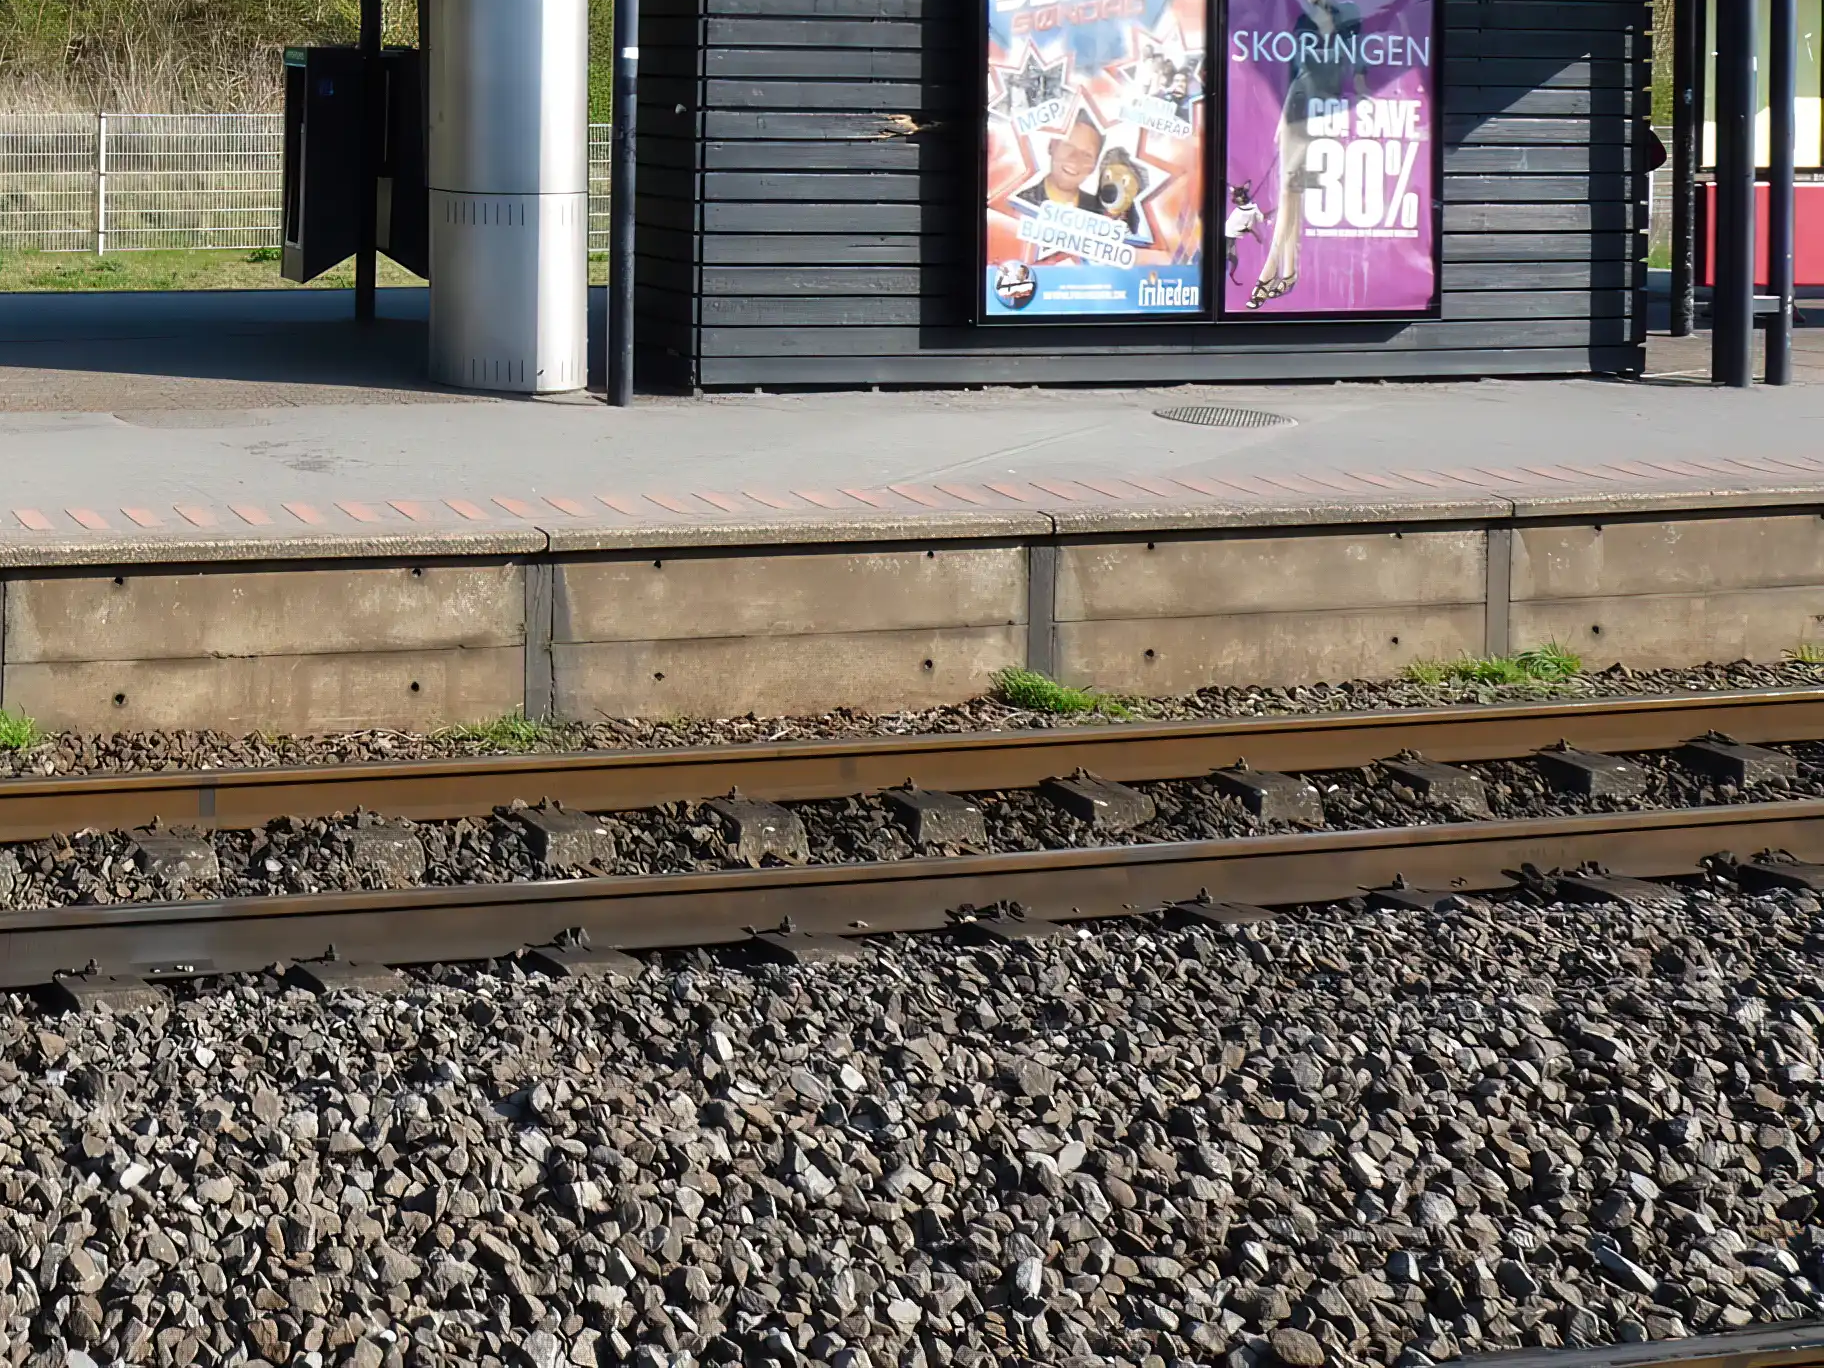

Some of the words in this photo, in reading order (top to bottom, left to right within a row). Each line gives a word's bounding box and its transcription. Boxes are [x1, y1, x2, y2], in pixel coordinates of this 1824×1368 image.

[1231, 30, 1431, 67] SKORINGEN
[1017, 101, 1060, 133] MGP
[1307, 97, 1350, 138] GO!
[1355, 98, 1422, 139] SAVE
[1303, 137, 1420, 229] 30%
[1042, 203, 1124, 242] SIGURDS
[1137, 279, 1200, 307] friheden
